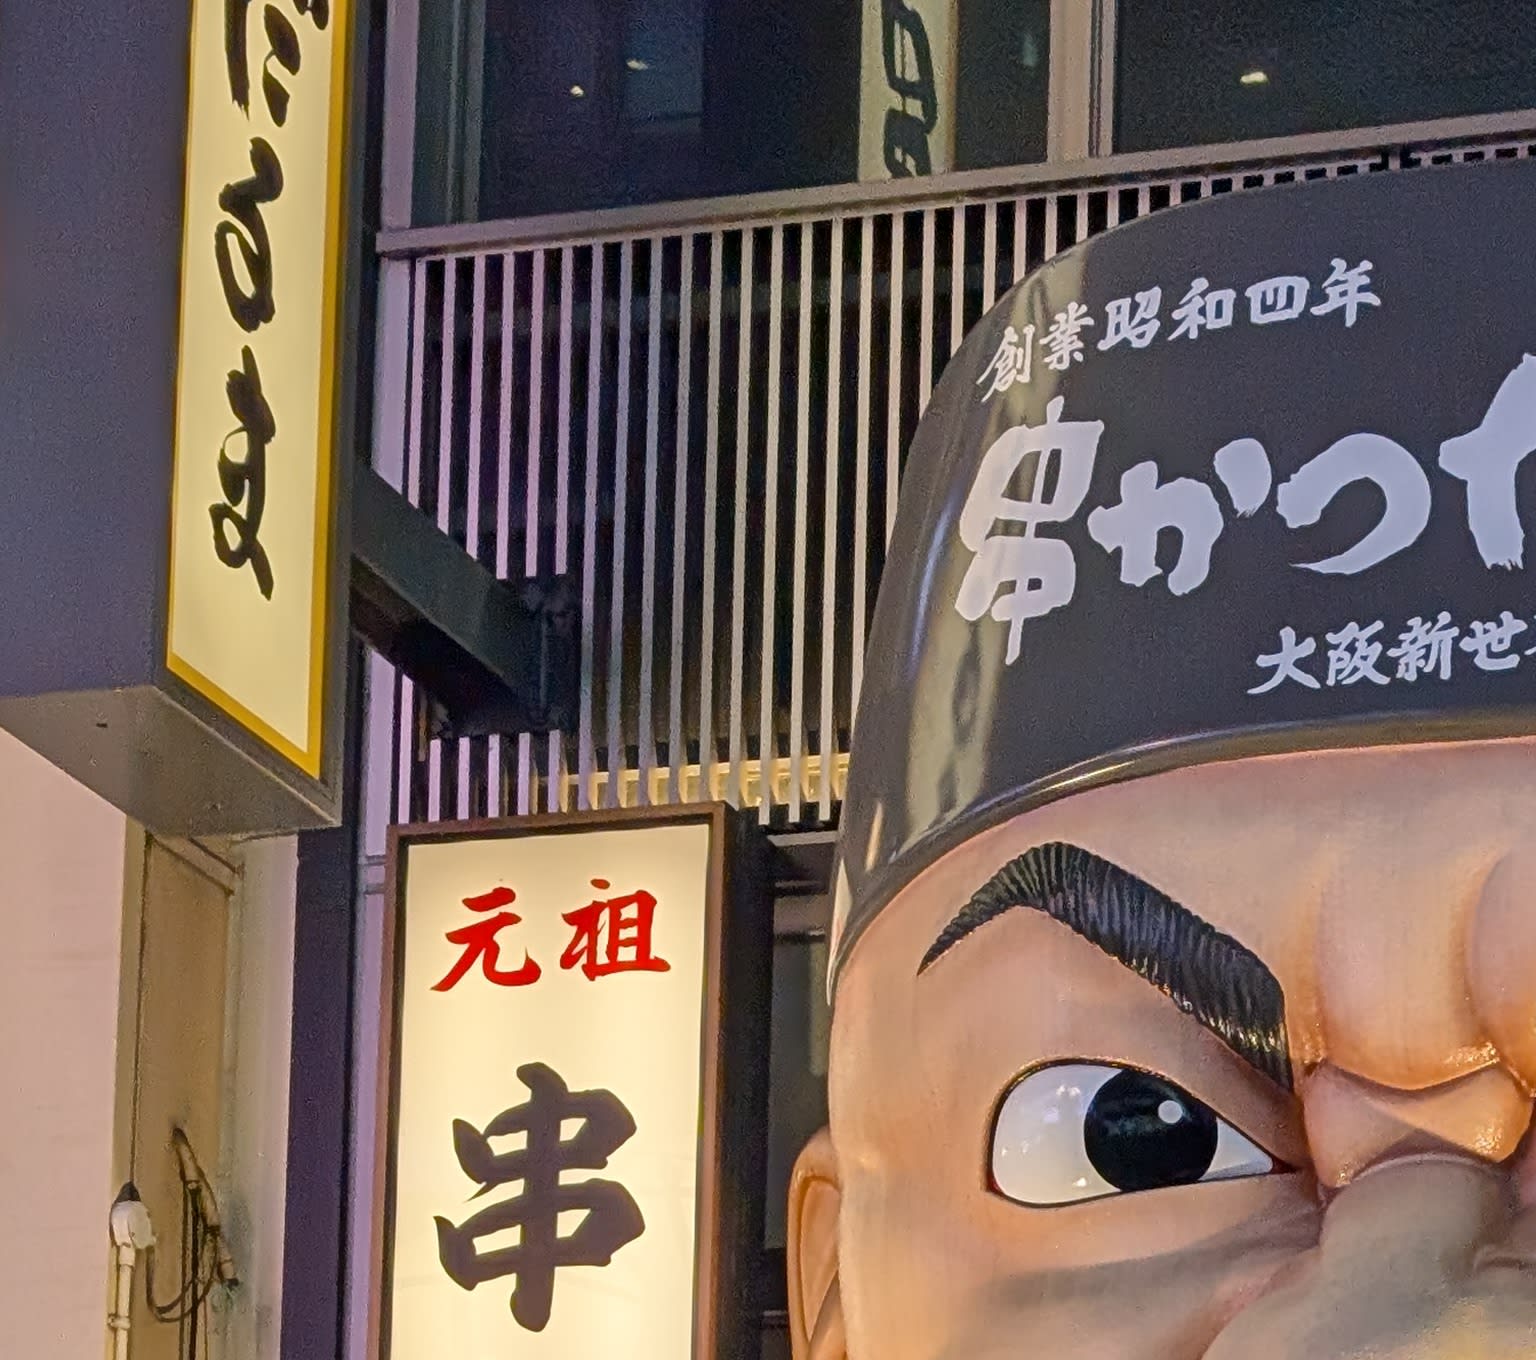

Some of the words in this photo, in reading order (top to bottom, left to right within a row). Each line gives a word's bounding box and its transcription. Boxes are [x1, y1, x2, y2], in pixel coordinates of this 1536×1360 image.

[976, 256, 1381, 401] 創業昭和四年
[430, 879, 671, 991] 元祖
